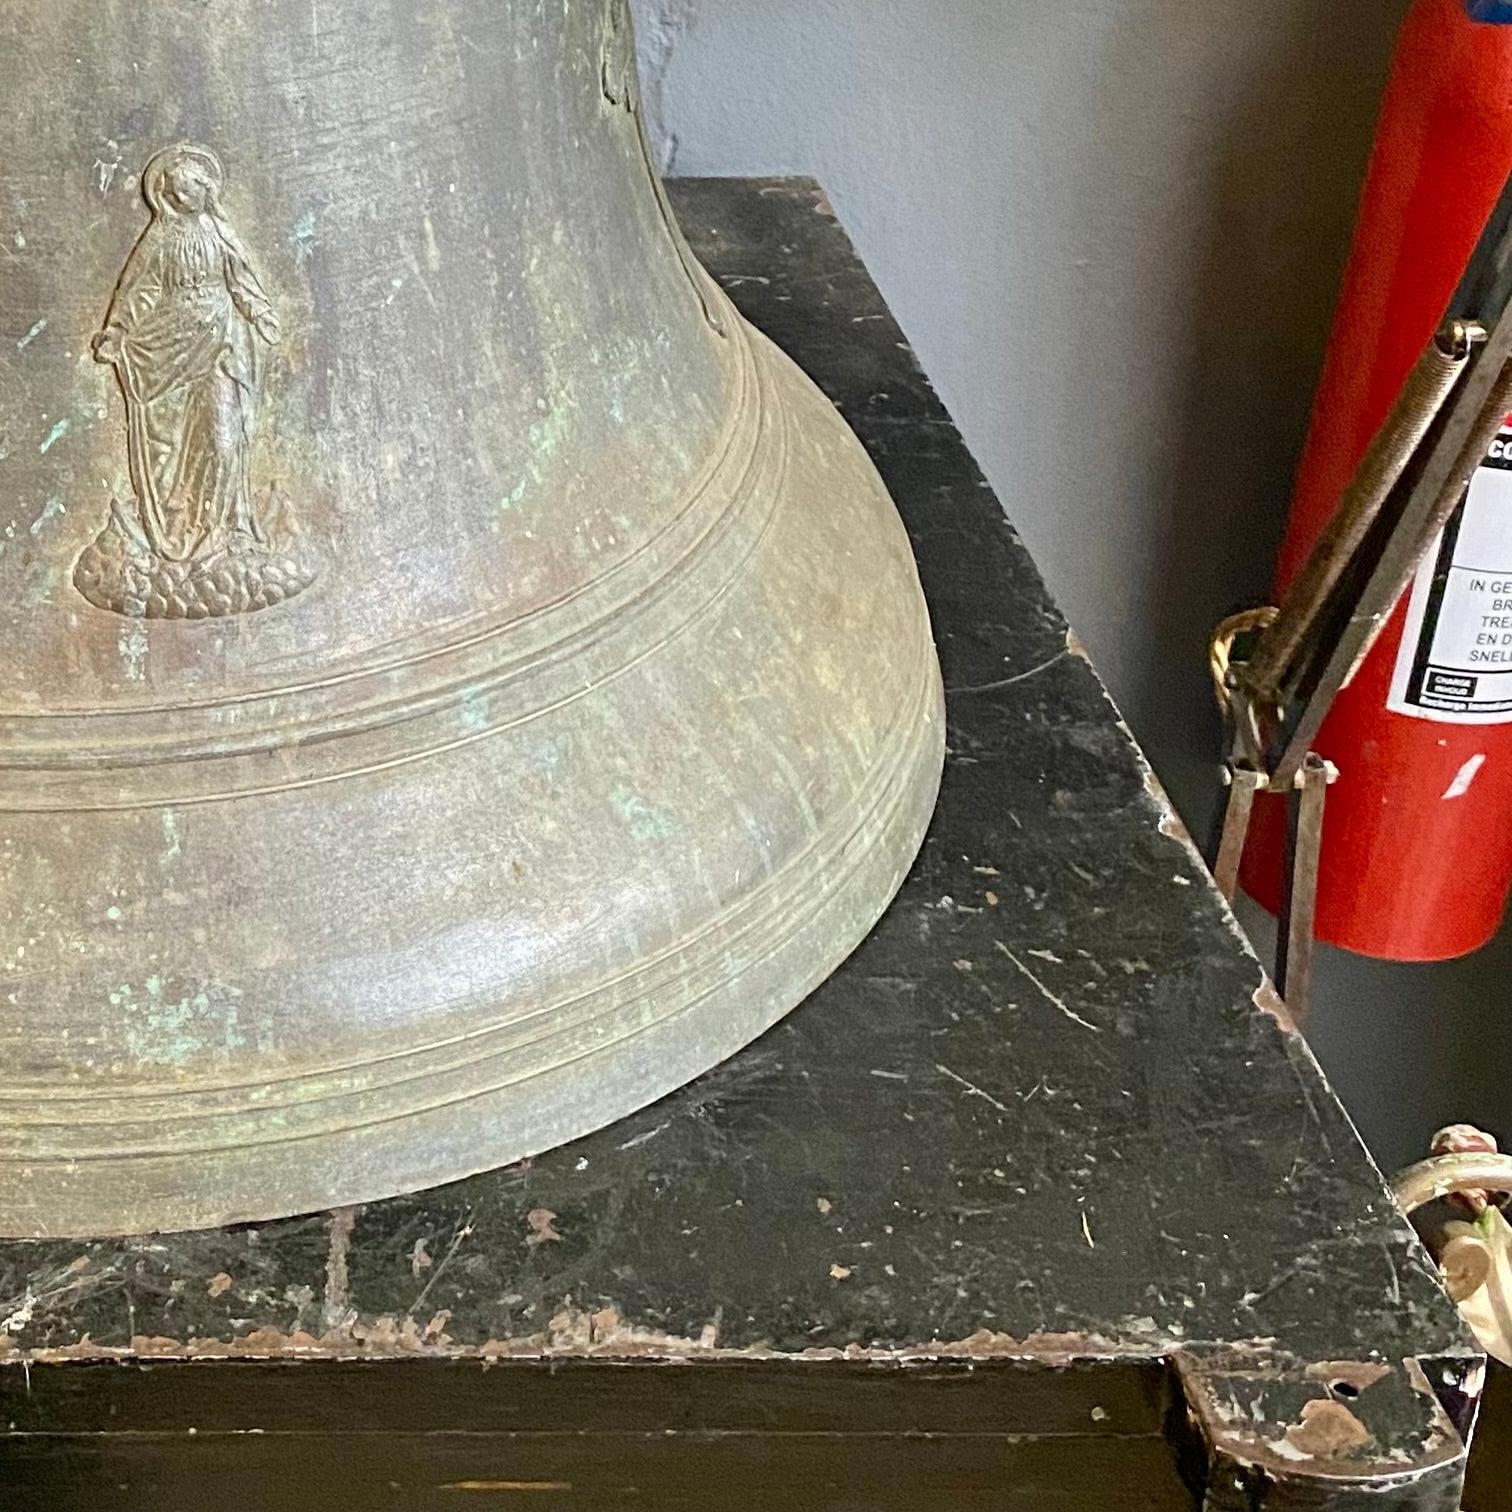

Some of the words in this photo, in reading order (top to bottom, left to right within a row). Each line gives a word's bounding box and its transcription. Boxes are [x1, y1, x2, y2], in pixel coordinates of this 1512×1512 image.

[1469, 579, 1486, 592] IN
[1491, 581, 1512, 594] GE
[1492, 599, 1512, 611] BR
[1482, 616, 1512, 628] TRE
[1476, 633, 1498, 645] EN
